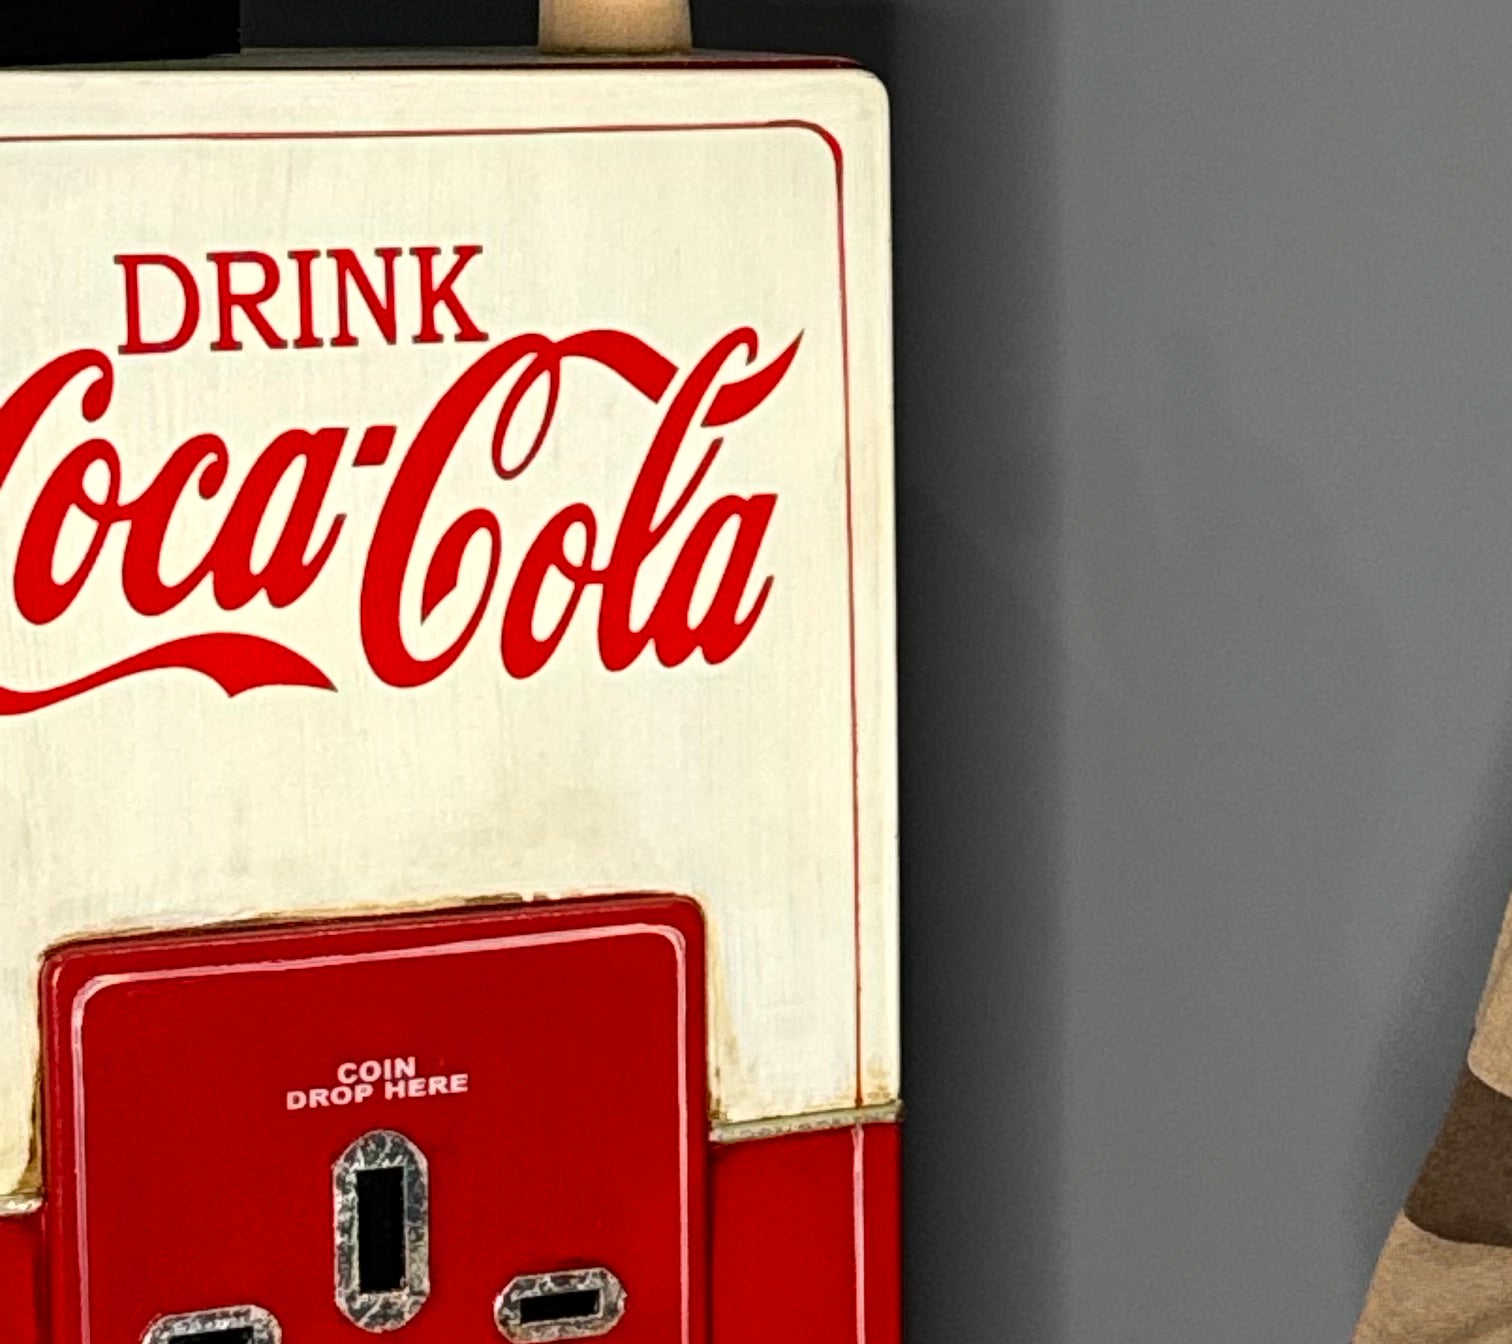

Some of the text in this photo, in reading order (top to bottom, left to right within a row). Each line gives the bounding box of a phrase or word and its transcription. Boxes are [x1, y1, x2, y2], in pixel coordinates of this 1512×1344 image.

[114, 244, 489, 356] DRINK
[337, 1056, 416, 1085] COIN
[286, 1073, 469, 1111] DROP HERE
